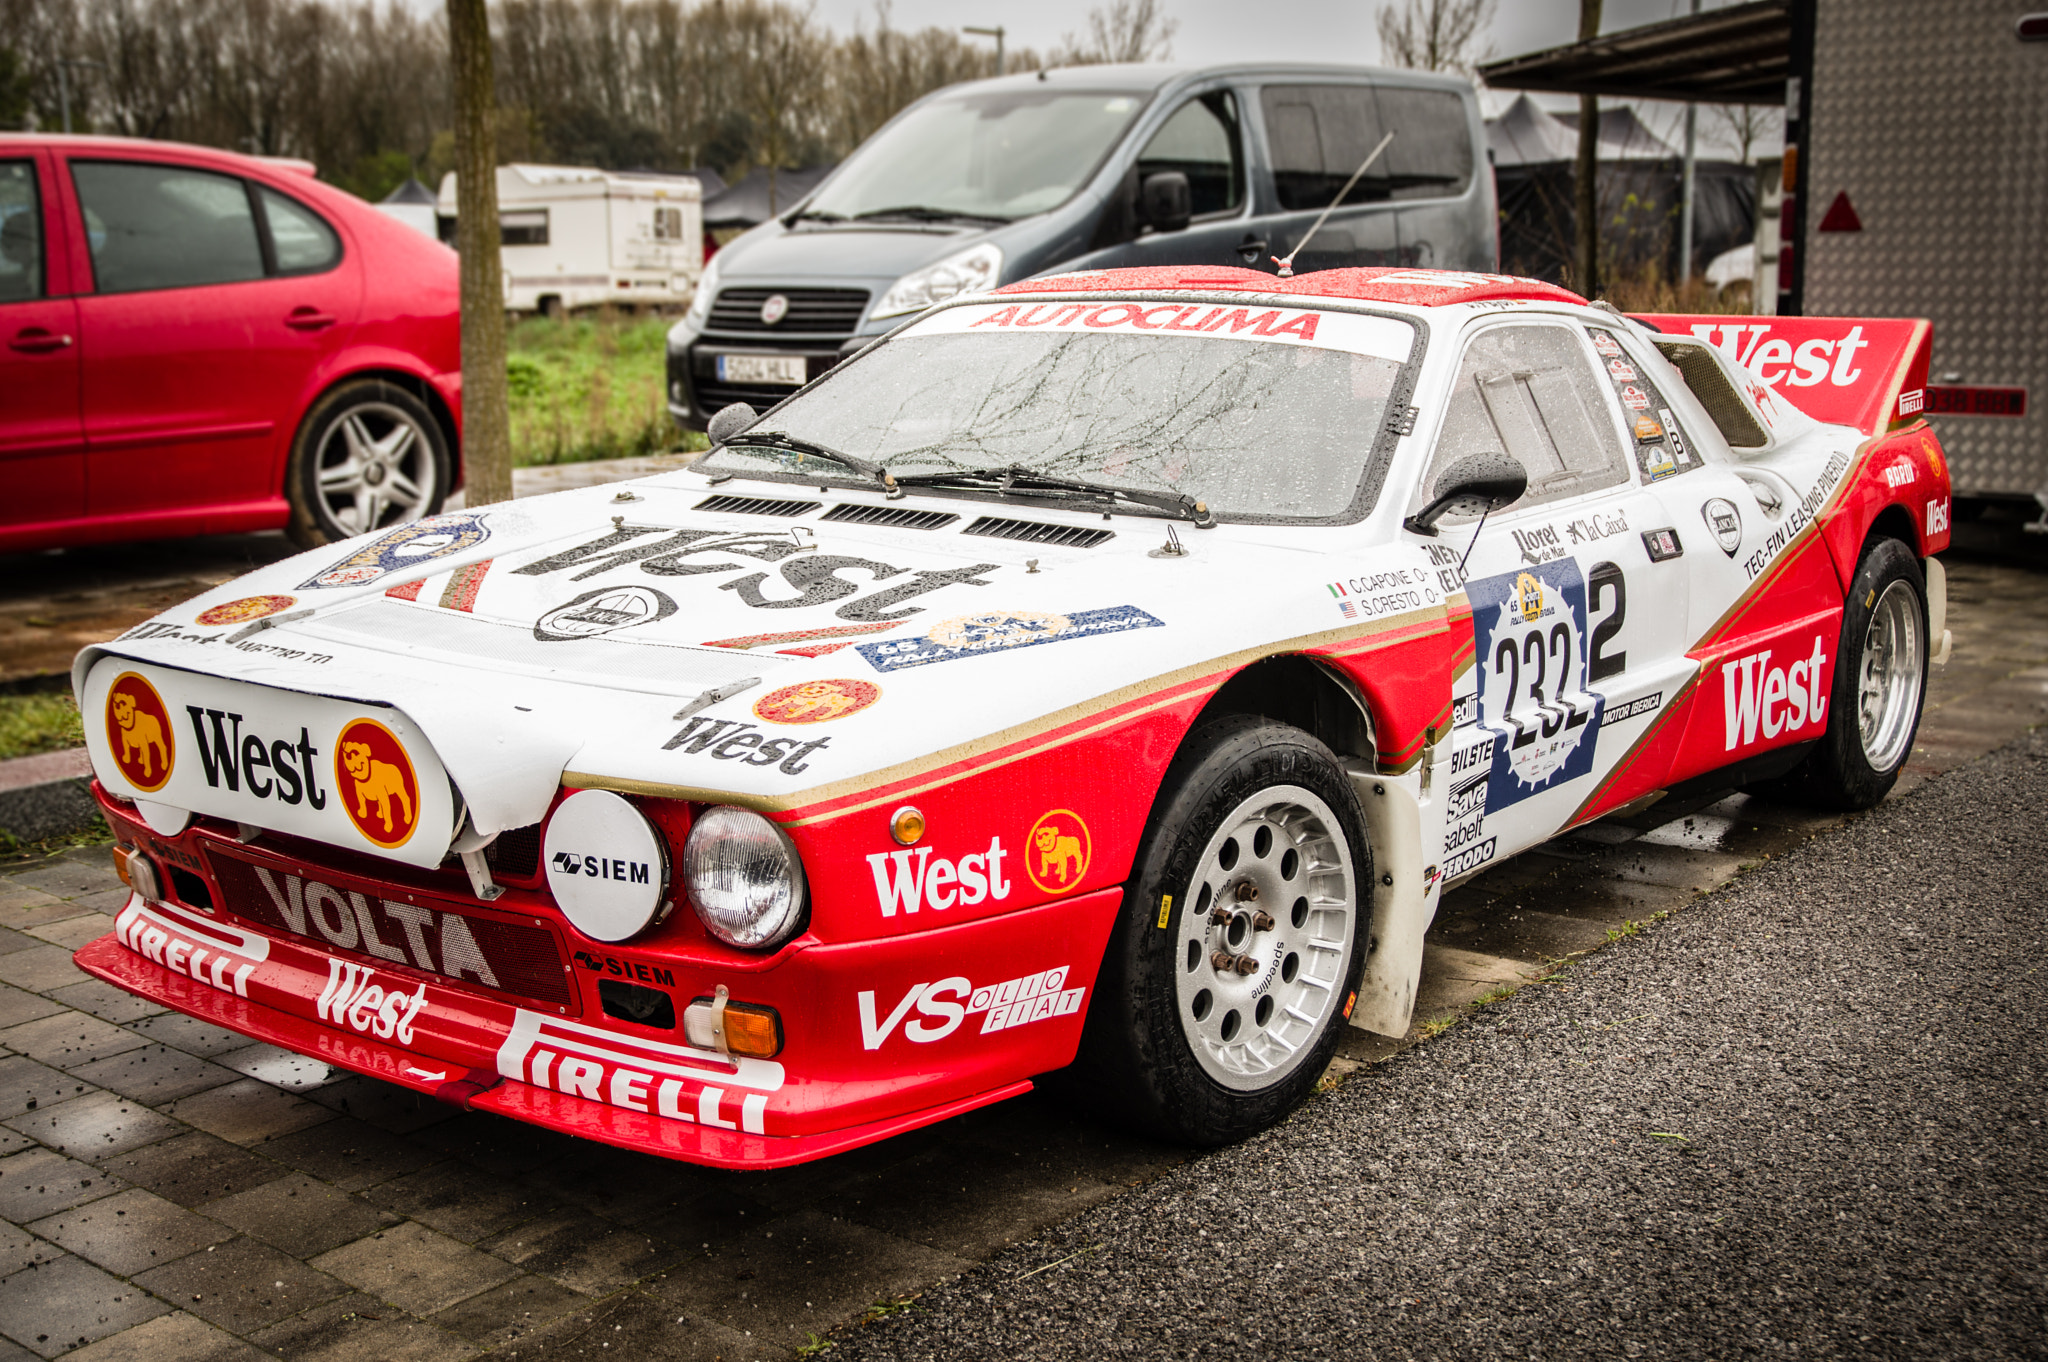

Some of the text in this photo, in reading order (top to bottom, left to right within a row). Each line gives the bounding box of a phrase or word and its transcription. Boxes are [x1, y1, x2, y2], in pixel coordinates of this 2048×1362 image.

[970, 304, 1321, 341] AUTOCLIMA
[1690, 324, 1869, 387] West
[1899, 388, 1924, 416] PIRELLI
[1885, 463, 1915, 488] BARDI
[1743, 527, 1787, 580] TEC-FIN
[1785, 485, 1824, 539] LEASING
[1926, 496, 1949, 537] West
[509, 526, 1002, 622] West
[1349, 570, 1413, 594] C.CAPONE
[1361, 590, 1421, 616] S.CRESTO
[1510, 600, 1518, 612] 65
[1588, 561, 1627, 685] 2
[876, 641, 919, 655] 65
[1496, 622, 1589, 751] 232
[1722, 636, 1827, 752] West
[1601, 694, 1660, 726] MOTOR IBERICA
[186, 704, 326, 810] West
[660, 716, 832, 776] West
[1448, 781, 1488, 823] Sava
[164, 845, 204, 872] SIEM
[584, 855, 649, 885] SIEM
[866, 836, 1011, 917] West
[1442, 840, 1494, 880] FERODO
[115, 891, 271, 998] PIRELLI
[253, 865, 500, 988] VOLTA
[606, 956, 676, 988] SIEM
[970, 968, 1066, 1012] OLIO
[1251, 941, 1285, 999] speedline
[317, 957, 429, 1046] West
[858, 976, 972, 1051] VS
[986, 985, 1080, 1030] FIAT
[497, 1008, 786, 1136] PIRELLI
